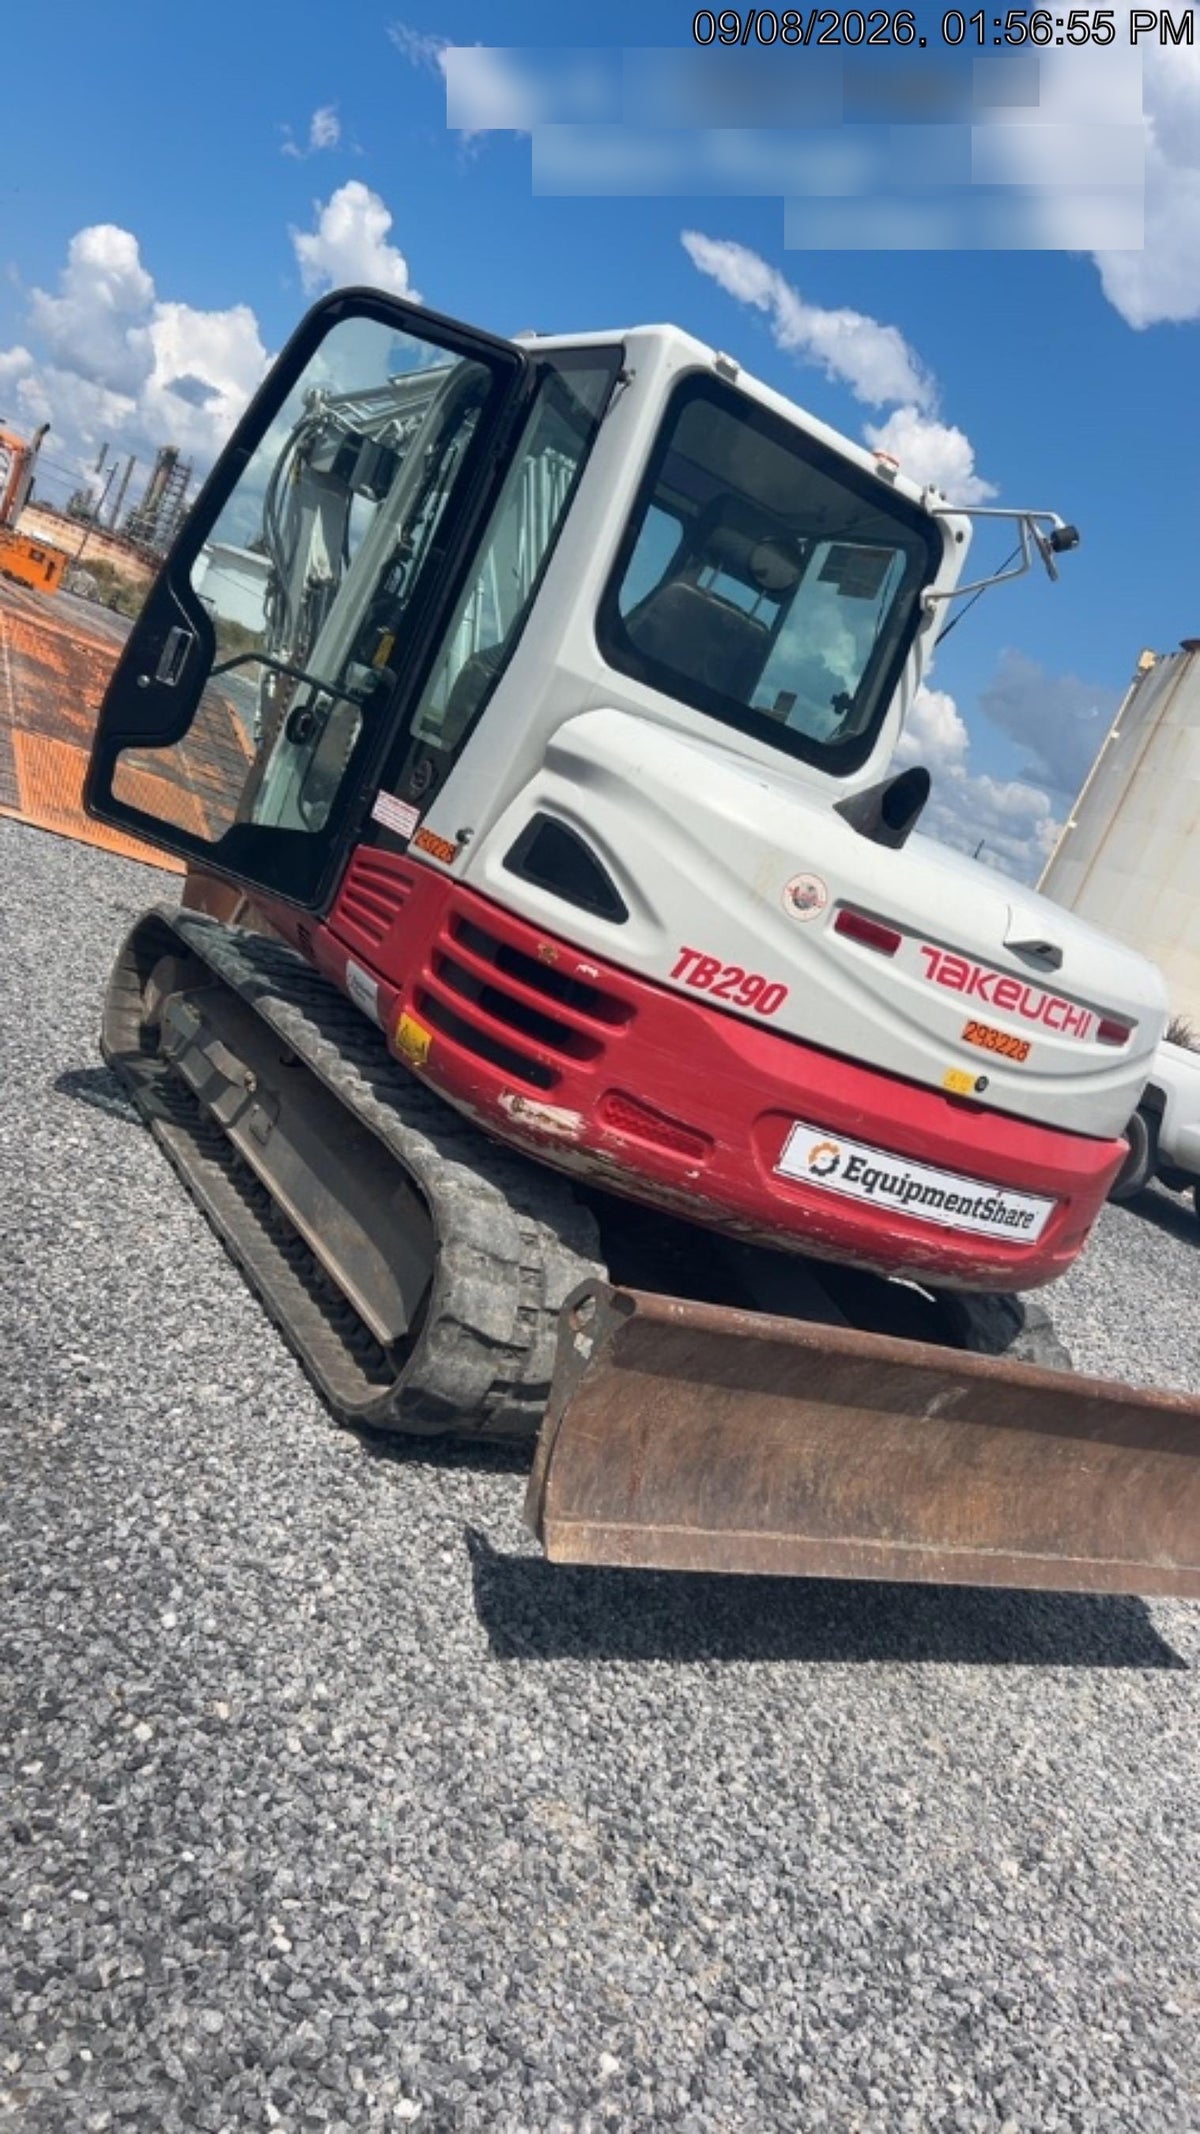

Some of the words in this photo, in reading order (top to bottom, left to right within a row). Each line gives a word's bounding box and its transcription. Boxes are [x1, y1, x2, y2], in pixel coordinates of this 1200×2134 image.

[669, 946, 789, 1017] TB290
[962, 1020, 1031, 1062] 293228
[841, 1154, 1036, 1230] EquipmentShare
